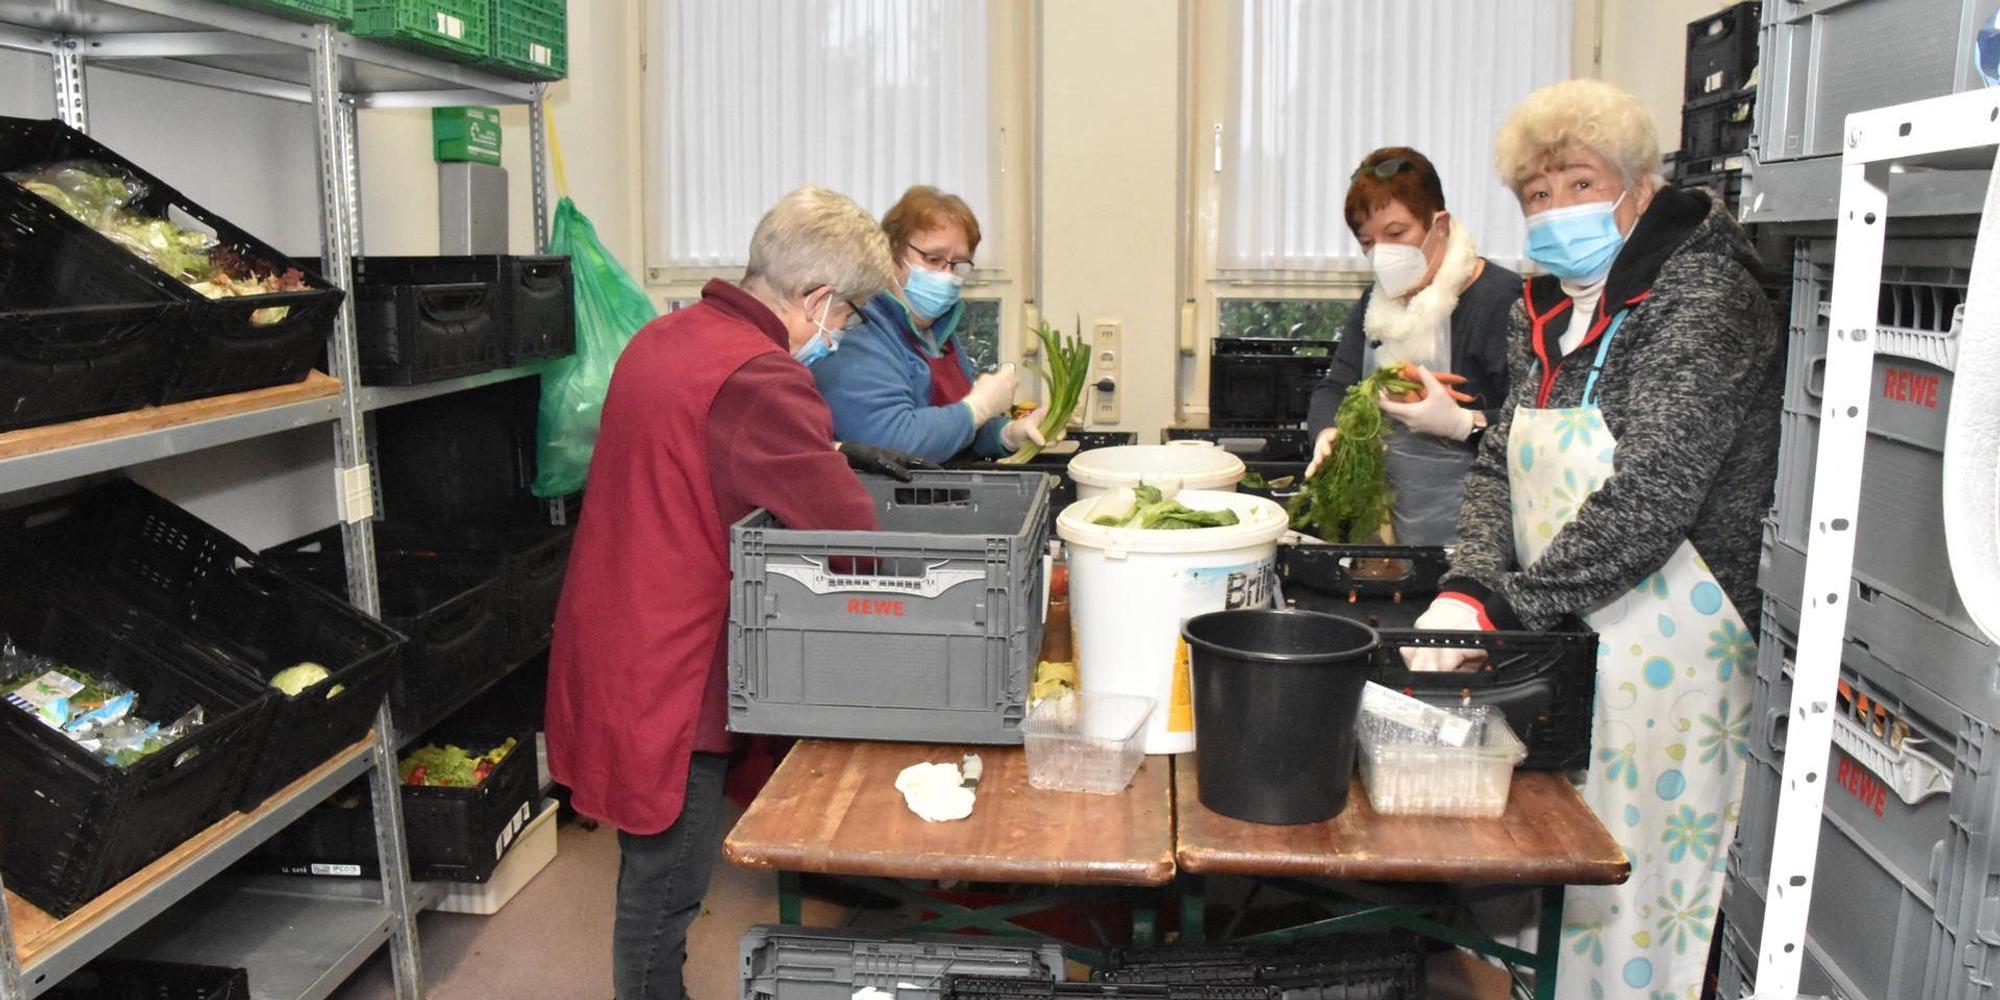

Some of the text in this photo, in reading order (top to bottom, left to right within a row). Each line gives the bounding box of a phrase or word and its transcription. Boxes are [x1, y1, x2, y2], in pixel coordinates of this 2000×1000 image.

[1884, 367, 1938, 409] REWE
[847, 598, 905, 617] REWE
[1837, 756, 1889, 818] REWE
